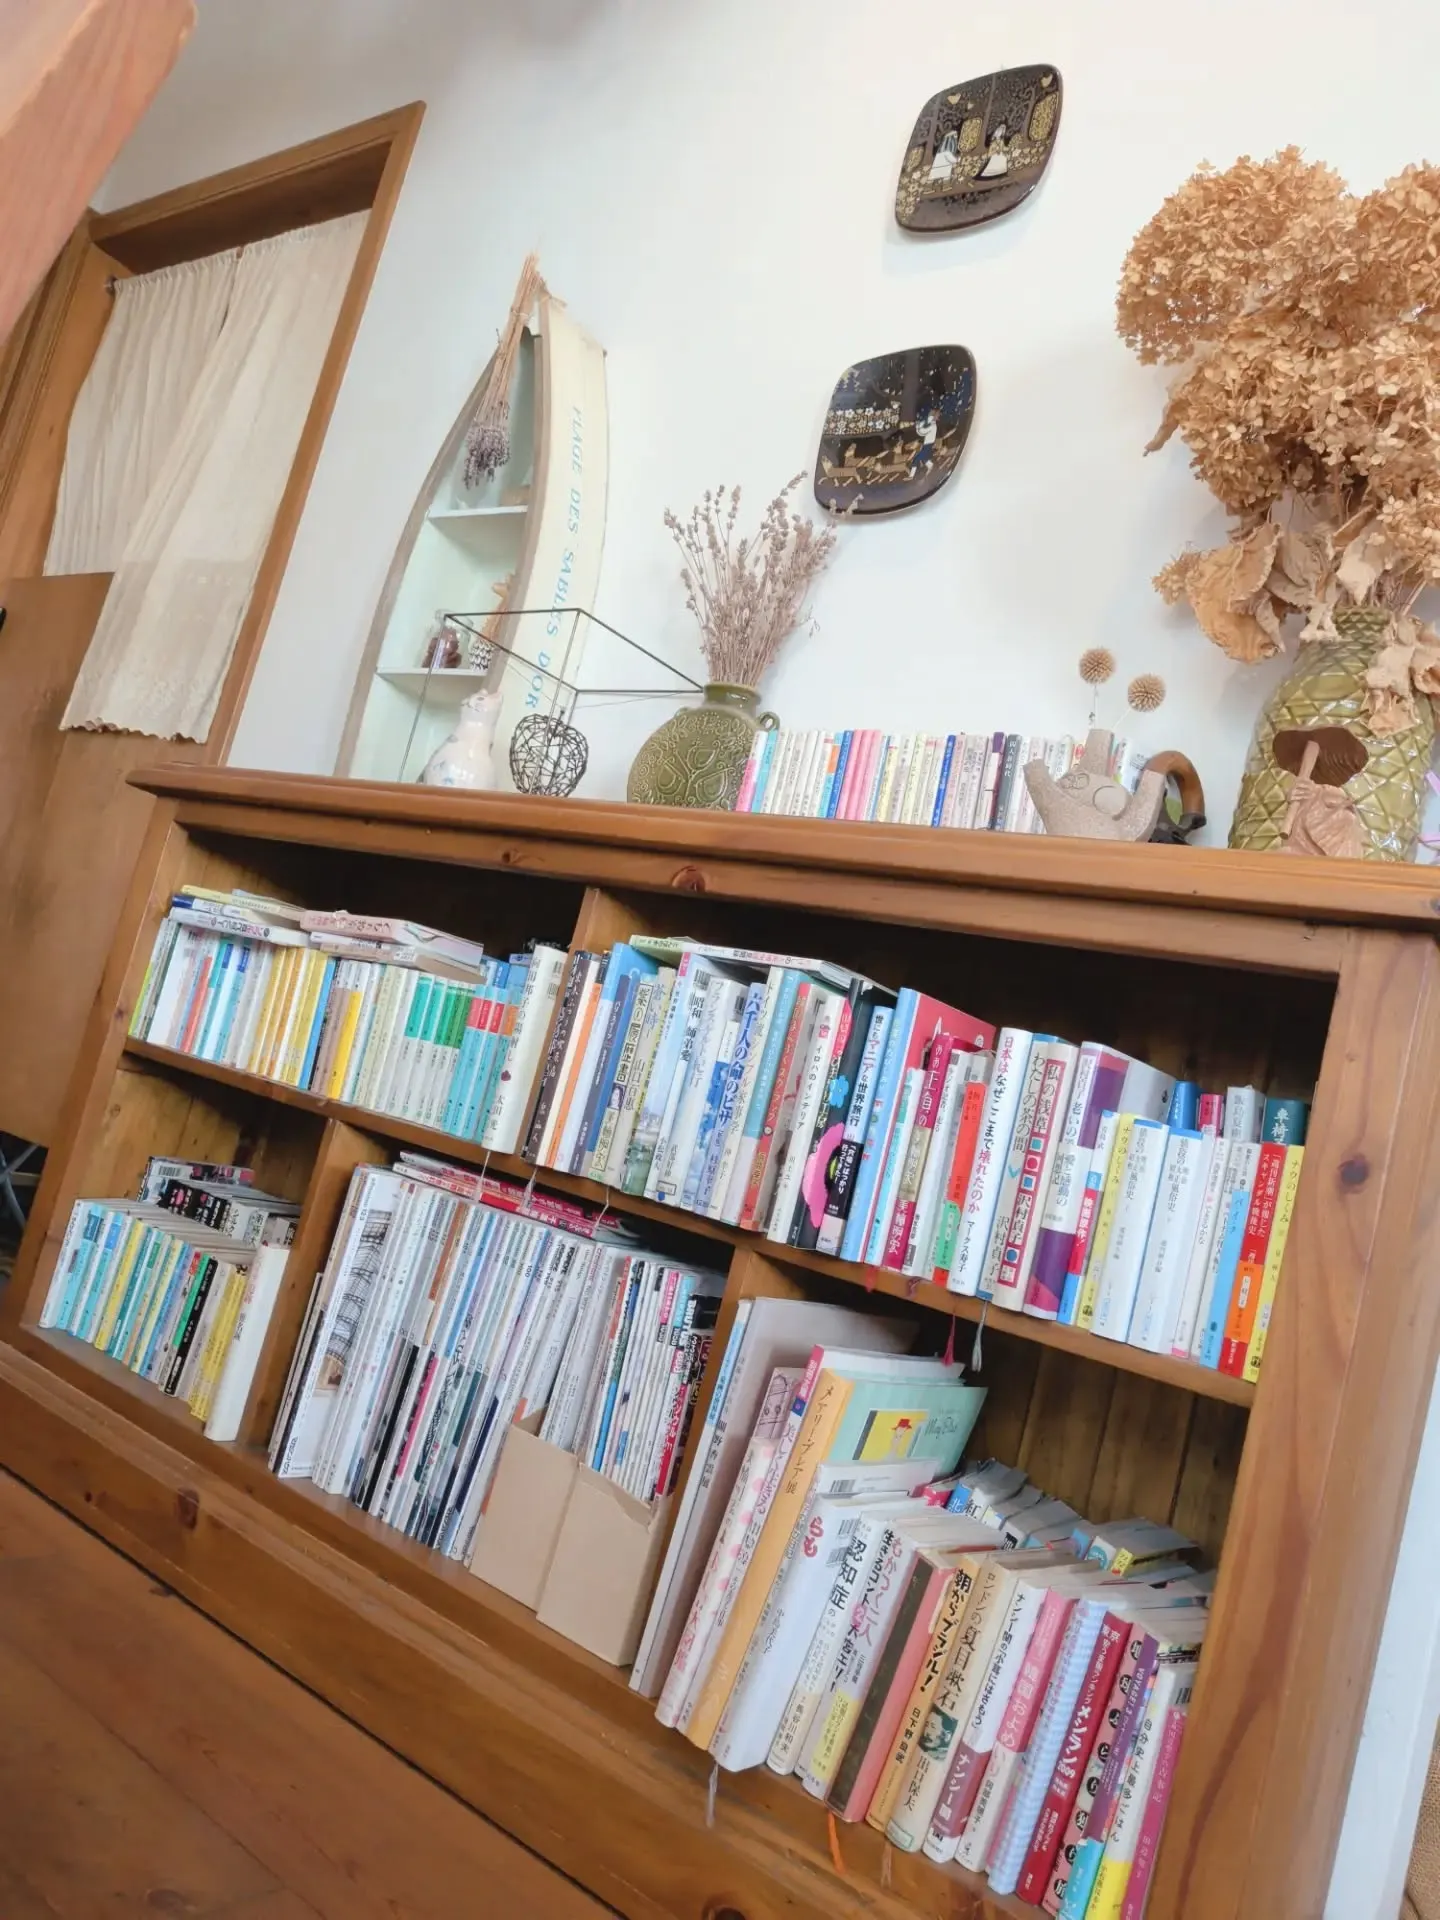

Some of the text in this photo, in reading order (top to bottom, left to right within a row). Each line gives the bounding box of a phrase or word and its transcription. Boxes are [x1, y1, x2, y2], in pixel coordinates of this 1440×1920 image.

[568, 487, 581, 535] DES
[713, 990, 765, 1132] 六千人の命のビザ
[846, 1013, 886, 1128] 世にもマニアな世界旅行
[966, 1034, 1017, 1215] 日本はなぜここまで壊れたのか
[986, 1052, 1046, 1278] わたしの茶の間 沢村貞子
[1008, 1063, 1060, 1246] 私の浅草 沢村貞子
[1247, 1152, 1270, 1236] スキャンダル戦後史
[1279, 1159, 1300, 1223] ナウのしくみ
[559, 1245, 575, 1276] POPEYE
[677, 1298, 697, 1347] BRUTUS
[782, 1382, 837, 1497] メアリー・ブレア展
[857, 1536, 908, 1646] むかつく二人
[915, 1567, 974, 1696] 朝からブラジル!
[937, 1570, 999, 1711] ロンドンの夏目漱石
[825, 1623, 862, 1694] 大宮エリー
[935, 1752, 972, 1820] ナンシー関
